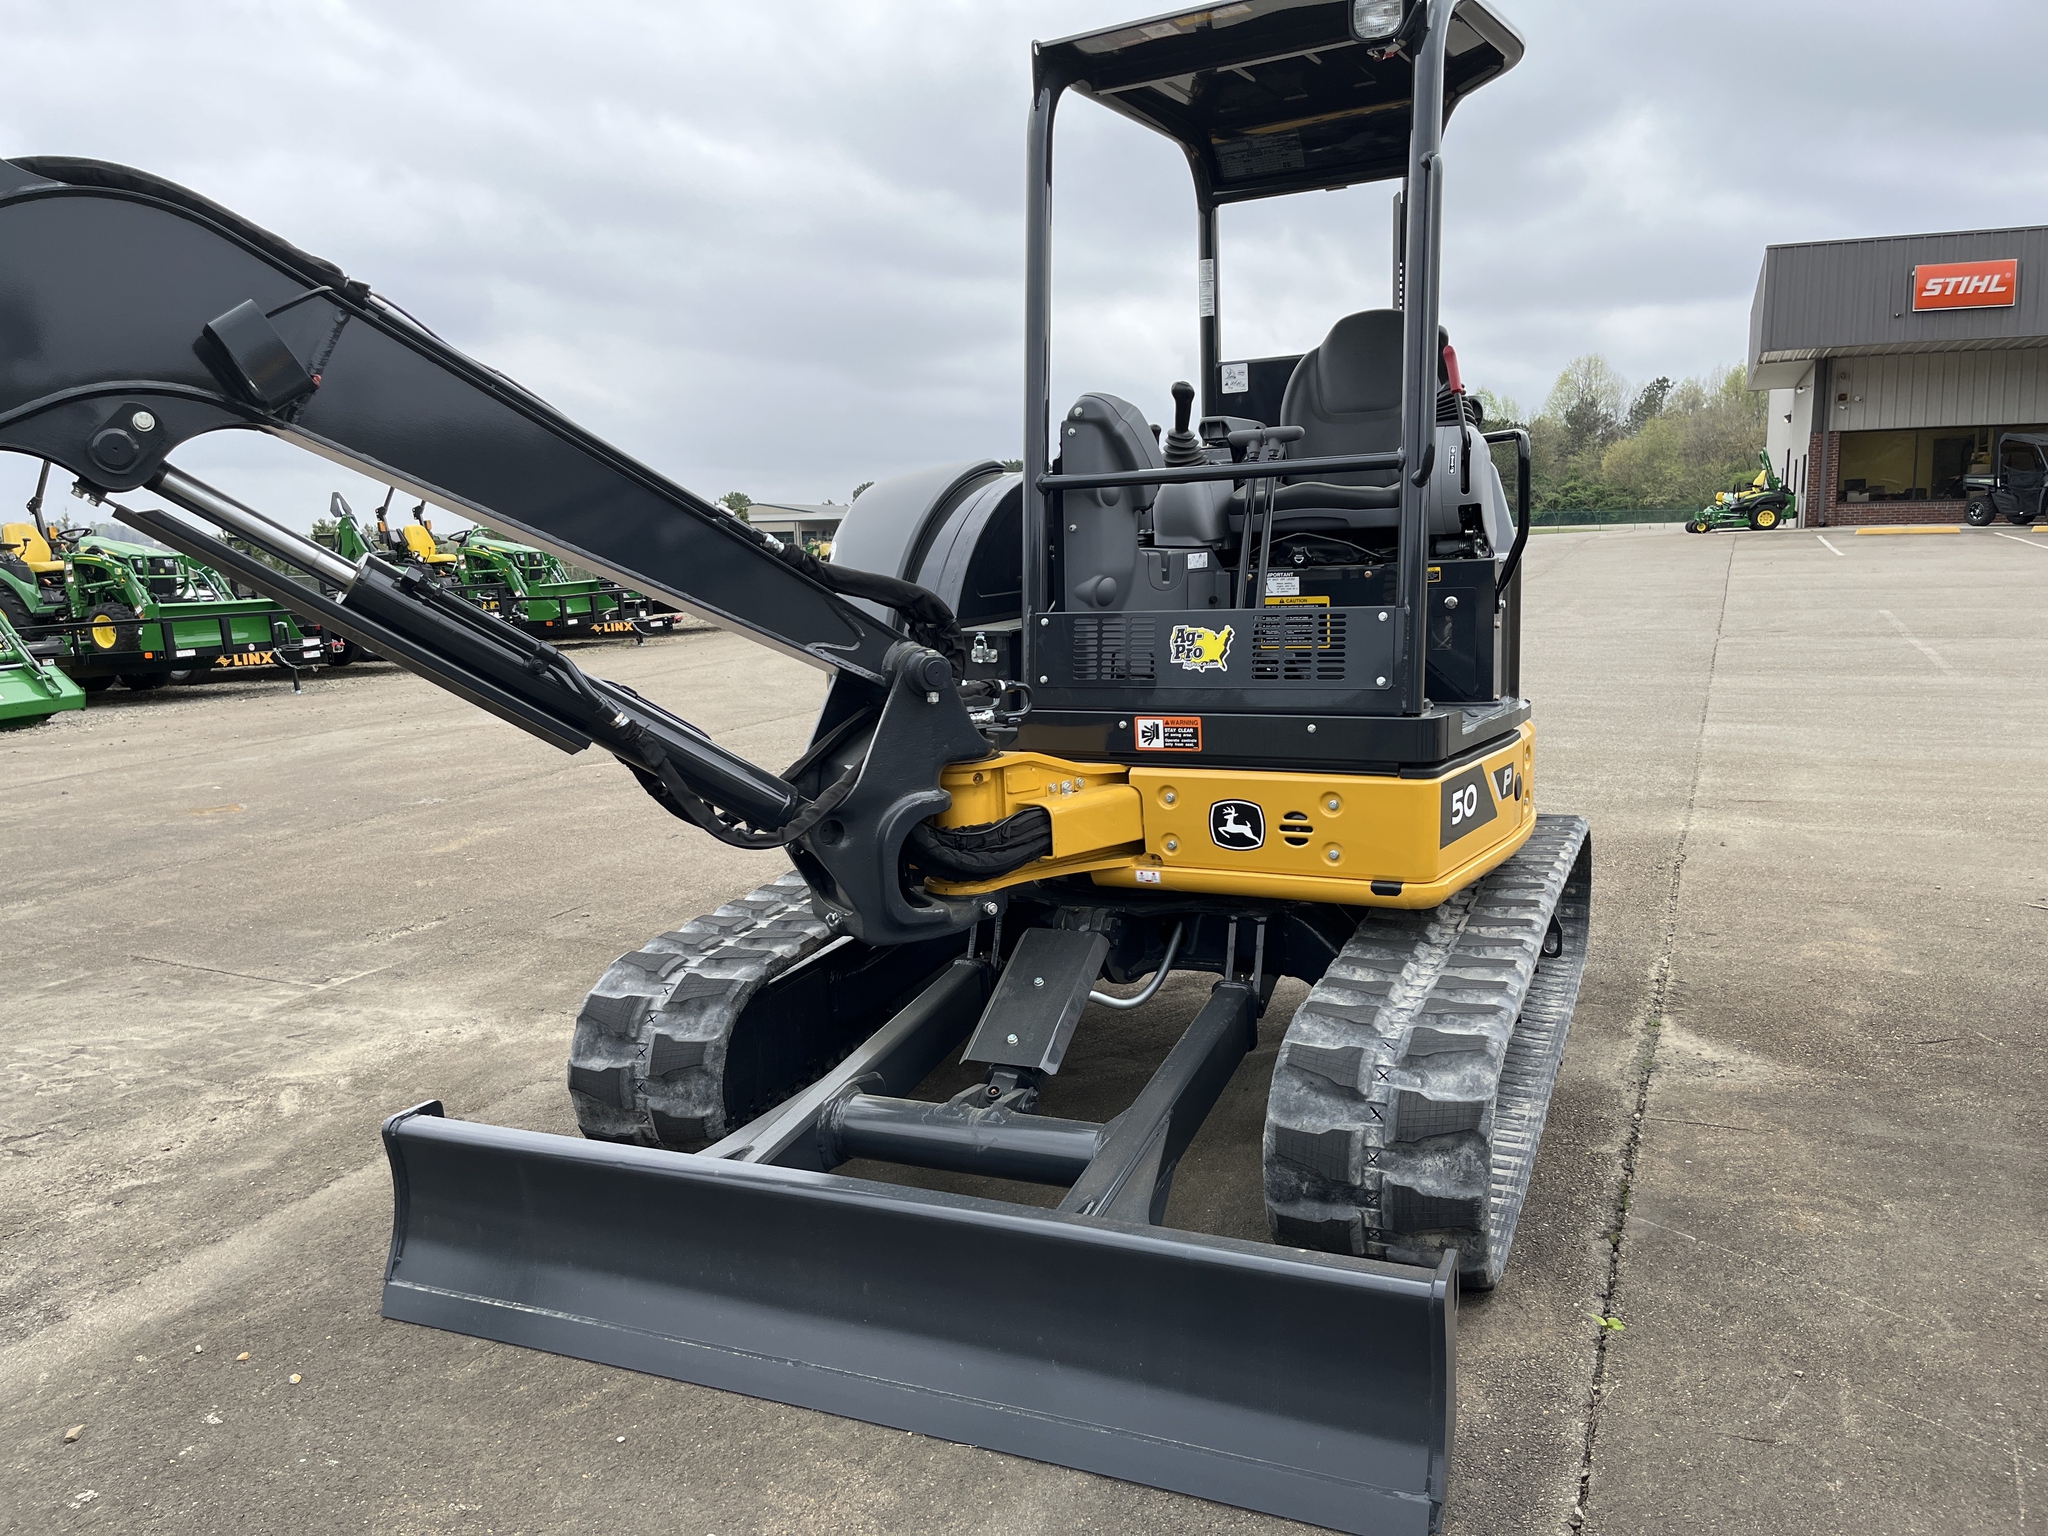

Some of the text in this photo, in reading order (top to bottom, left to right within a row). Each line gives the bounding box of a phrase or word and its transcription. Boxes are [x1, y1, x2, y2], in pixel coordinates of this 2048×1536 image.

[1921, 274, 2007, 296] STIHL
[603, 622, 634, 632] LINX
[1174, 629, 1203, 647] Ag-
[233, 652, 274, 666] LINX
[1174, 645, 1203, 660] Pro
[1452, 767, 1512, 825] 50 P
